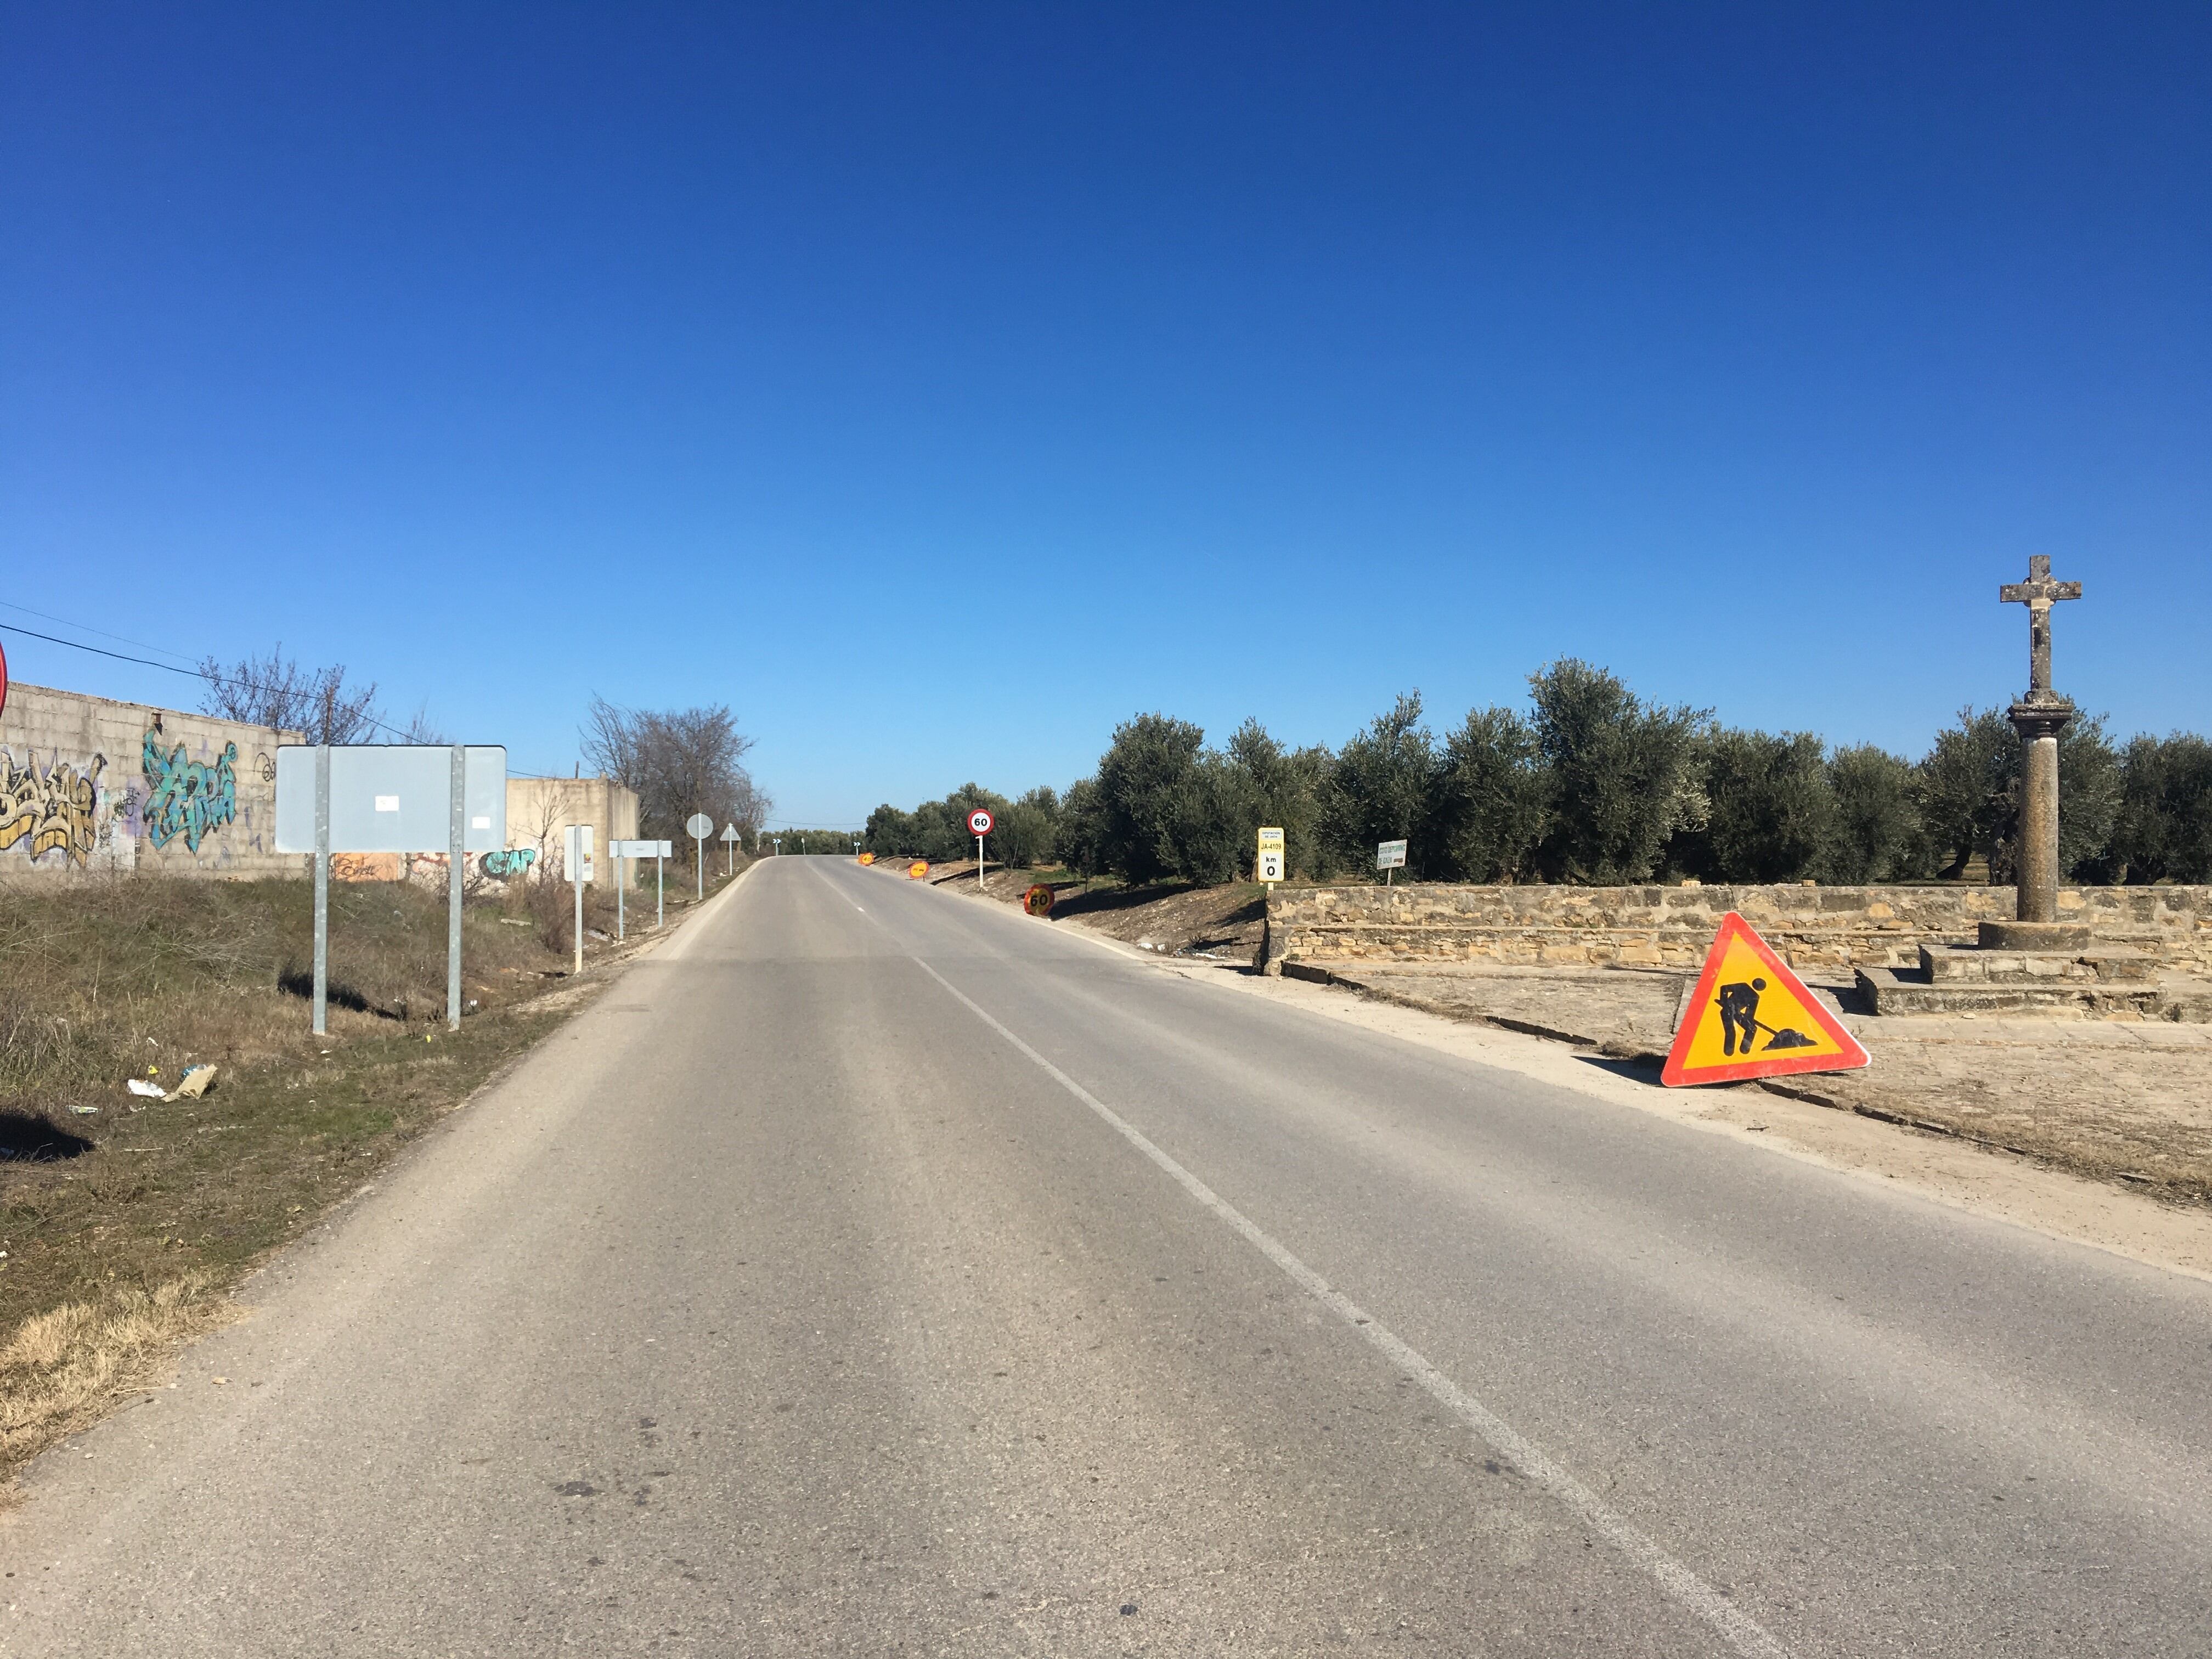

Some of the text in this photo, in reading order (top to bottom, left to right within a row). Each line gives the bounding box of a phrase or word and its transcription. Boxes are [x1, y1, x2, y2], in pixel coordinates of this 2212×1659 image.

[974, 818, 988, 826] 60
[1267, 866, 1275, 876] 0
[1030, 894, 1048, 906] 60
